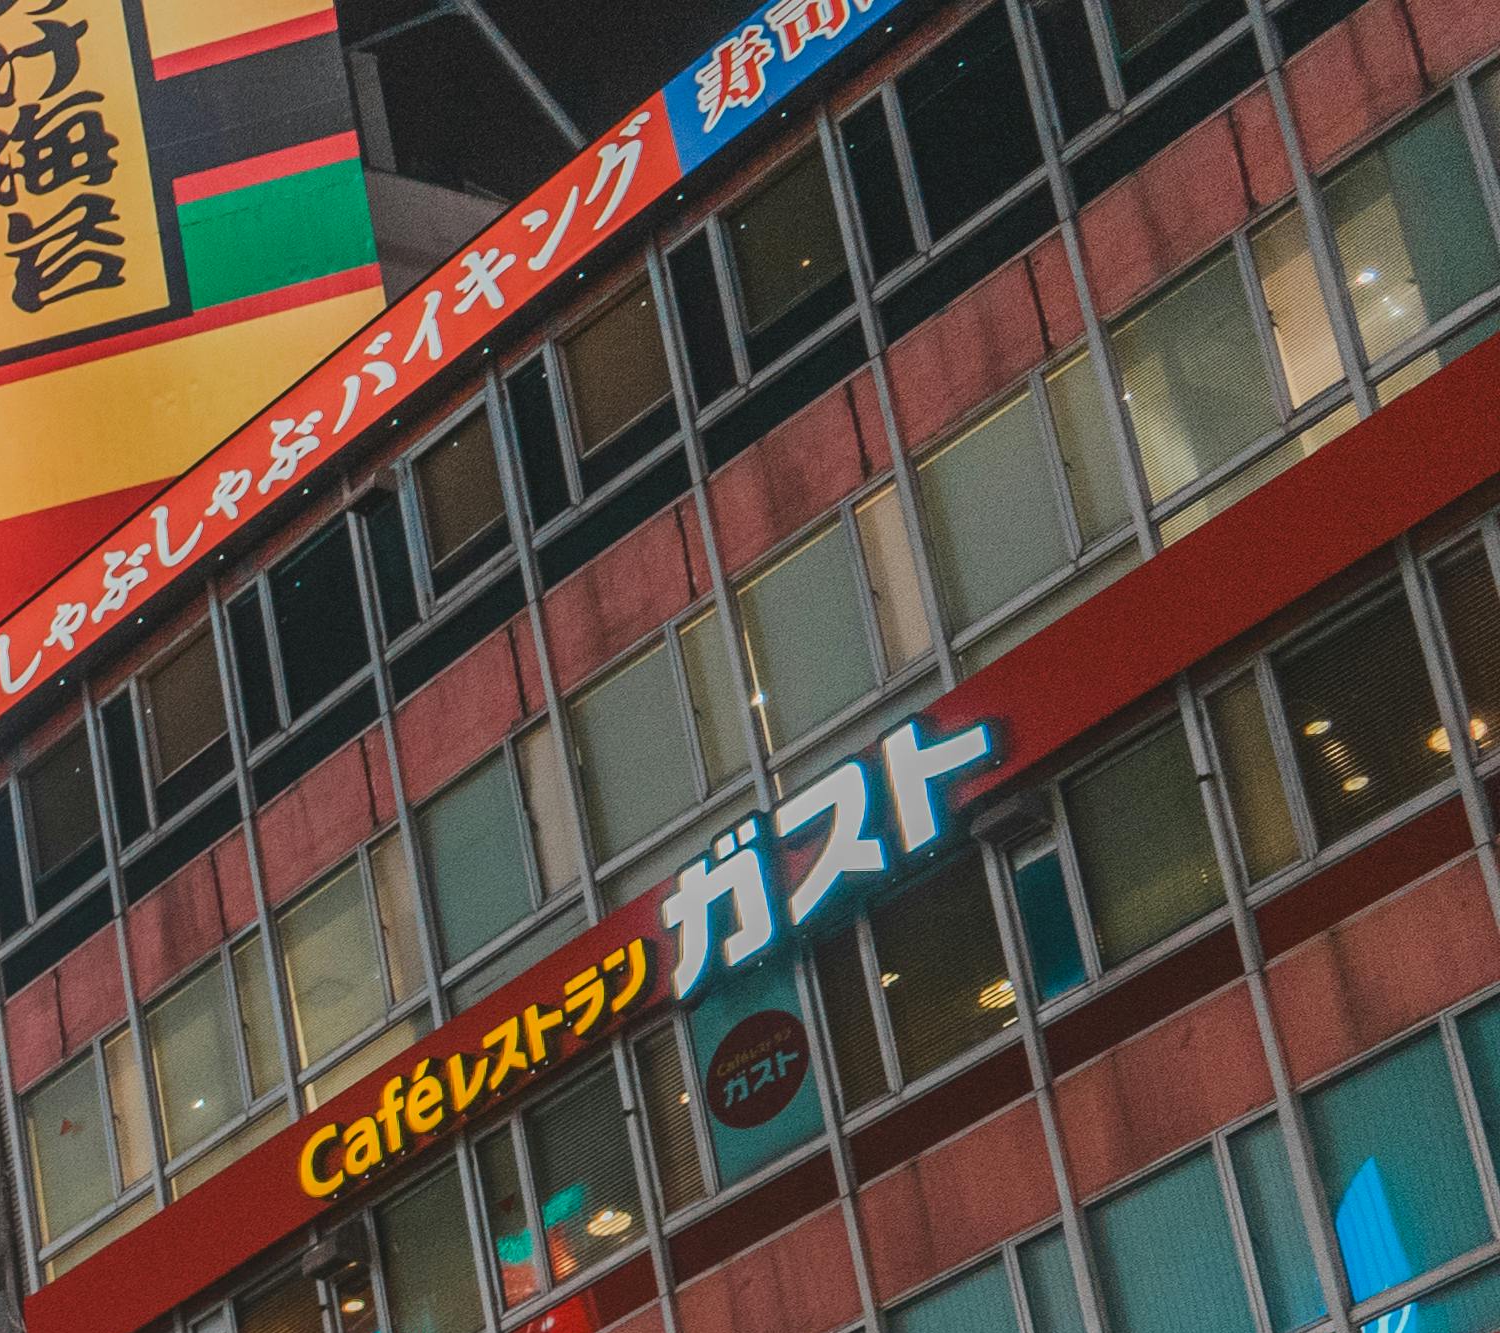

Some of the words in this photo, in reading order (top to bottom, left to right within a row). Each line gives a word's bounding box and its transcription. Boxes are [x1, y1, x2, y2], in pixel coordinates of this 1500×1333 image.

[695, 0, 895, 133] 寿司
[299, 937, 648, 1198] Caféレストラン
[662, 719, 990, 1001] ガスト
[722, 1048, 800, 1110] ガスト
